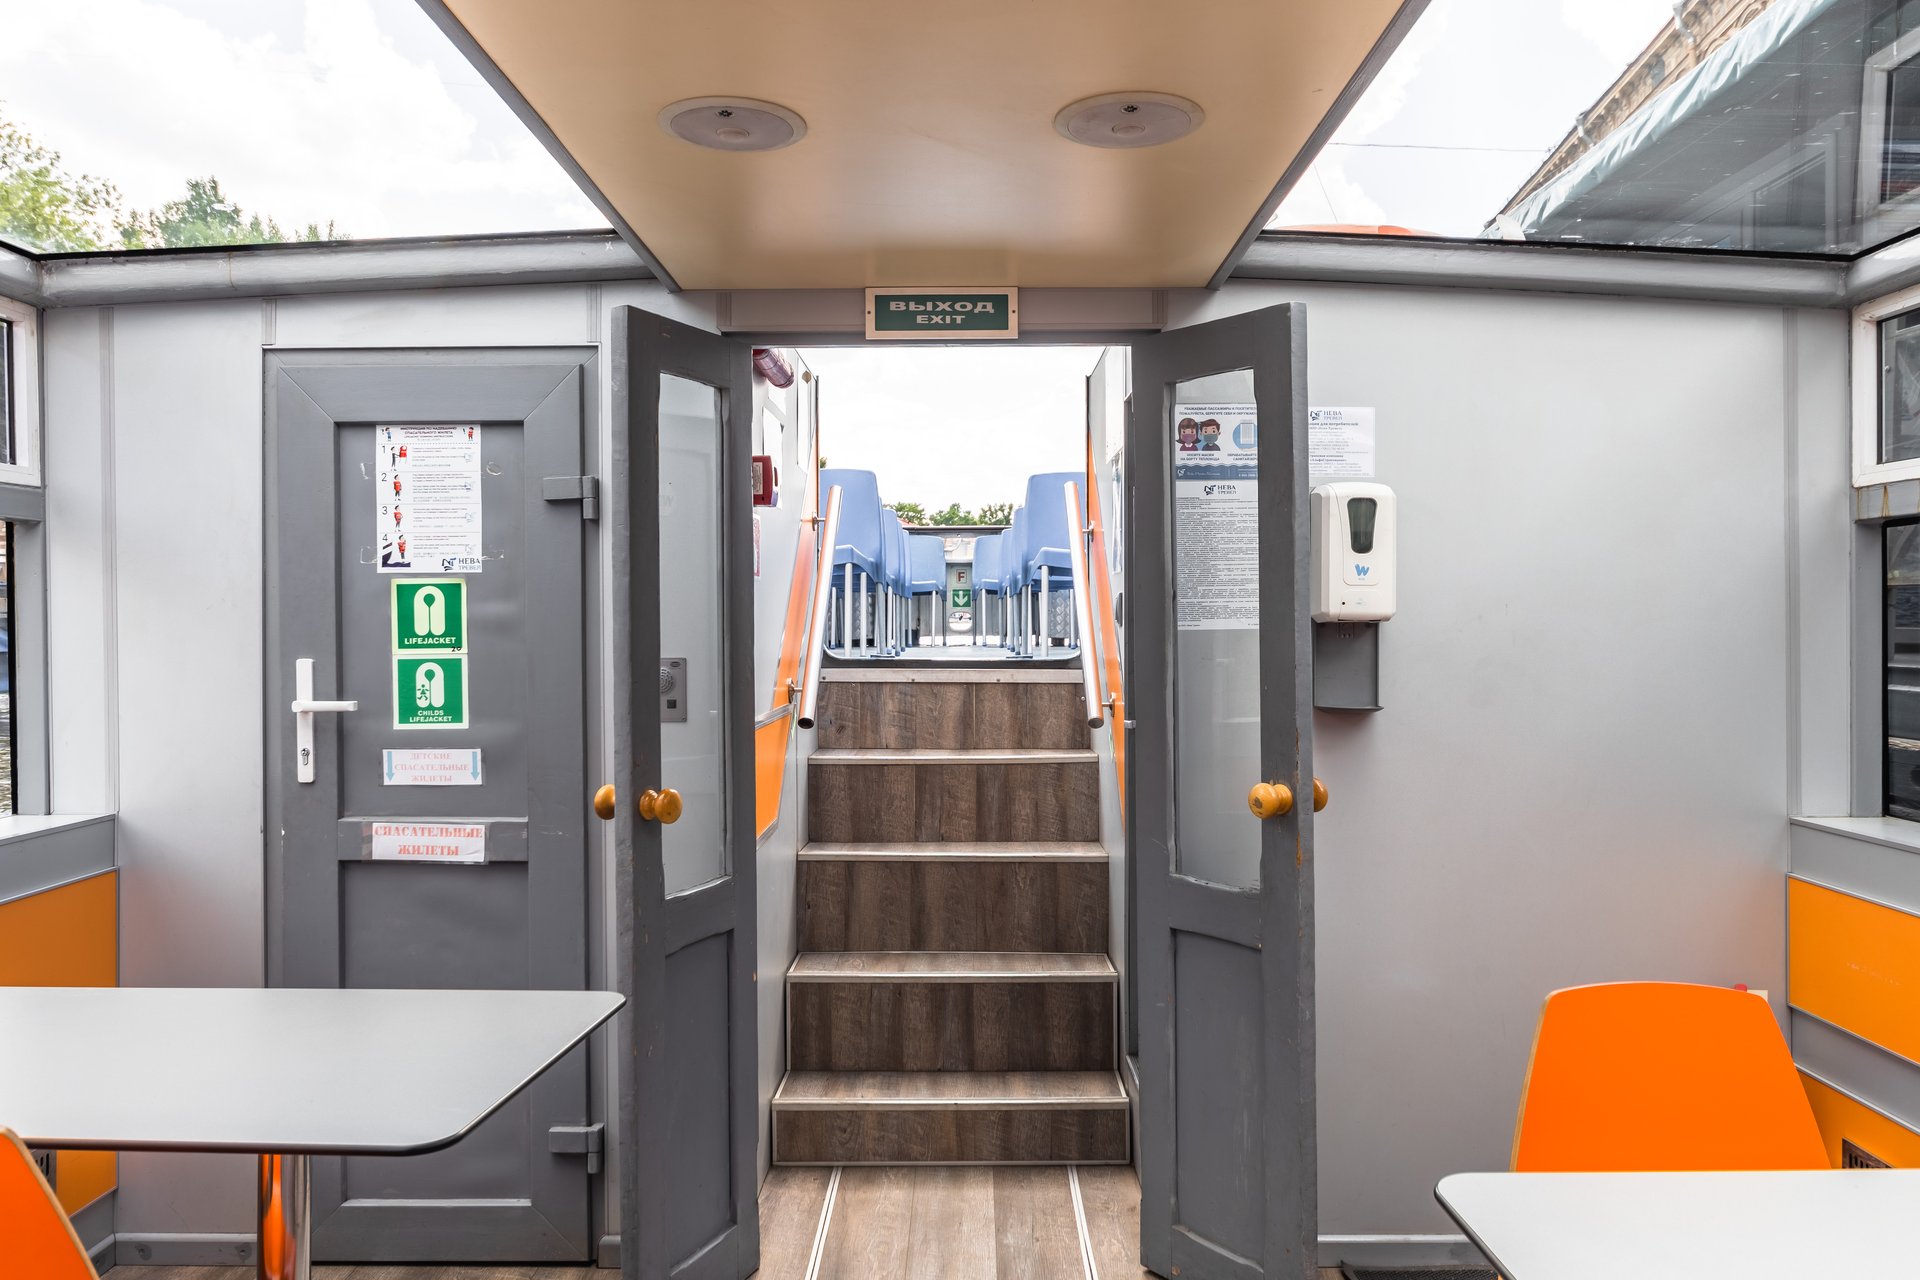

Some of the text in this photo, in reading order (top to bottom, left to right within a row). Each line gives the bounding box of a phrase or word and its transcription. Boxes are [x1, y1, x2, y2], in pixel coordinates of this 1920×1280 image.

[889, 301, 995, 314] ВЫХОД
[916, 315, 966, 324] EXIT
[382, 445, 386, 454] 1
[381, 473, 387, 482] 2
[382, 506, 388, 515] 3
[404, 637, 456, 645] LIFEJACKET
[374, 826, 483, 838] СПАСАТЕЛЬНЫЕ
[398, 845, 460, 856] ЖИЛЕТЫ
